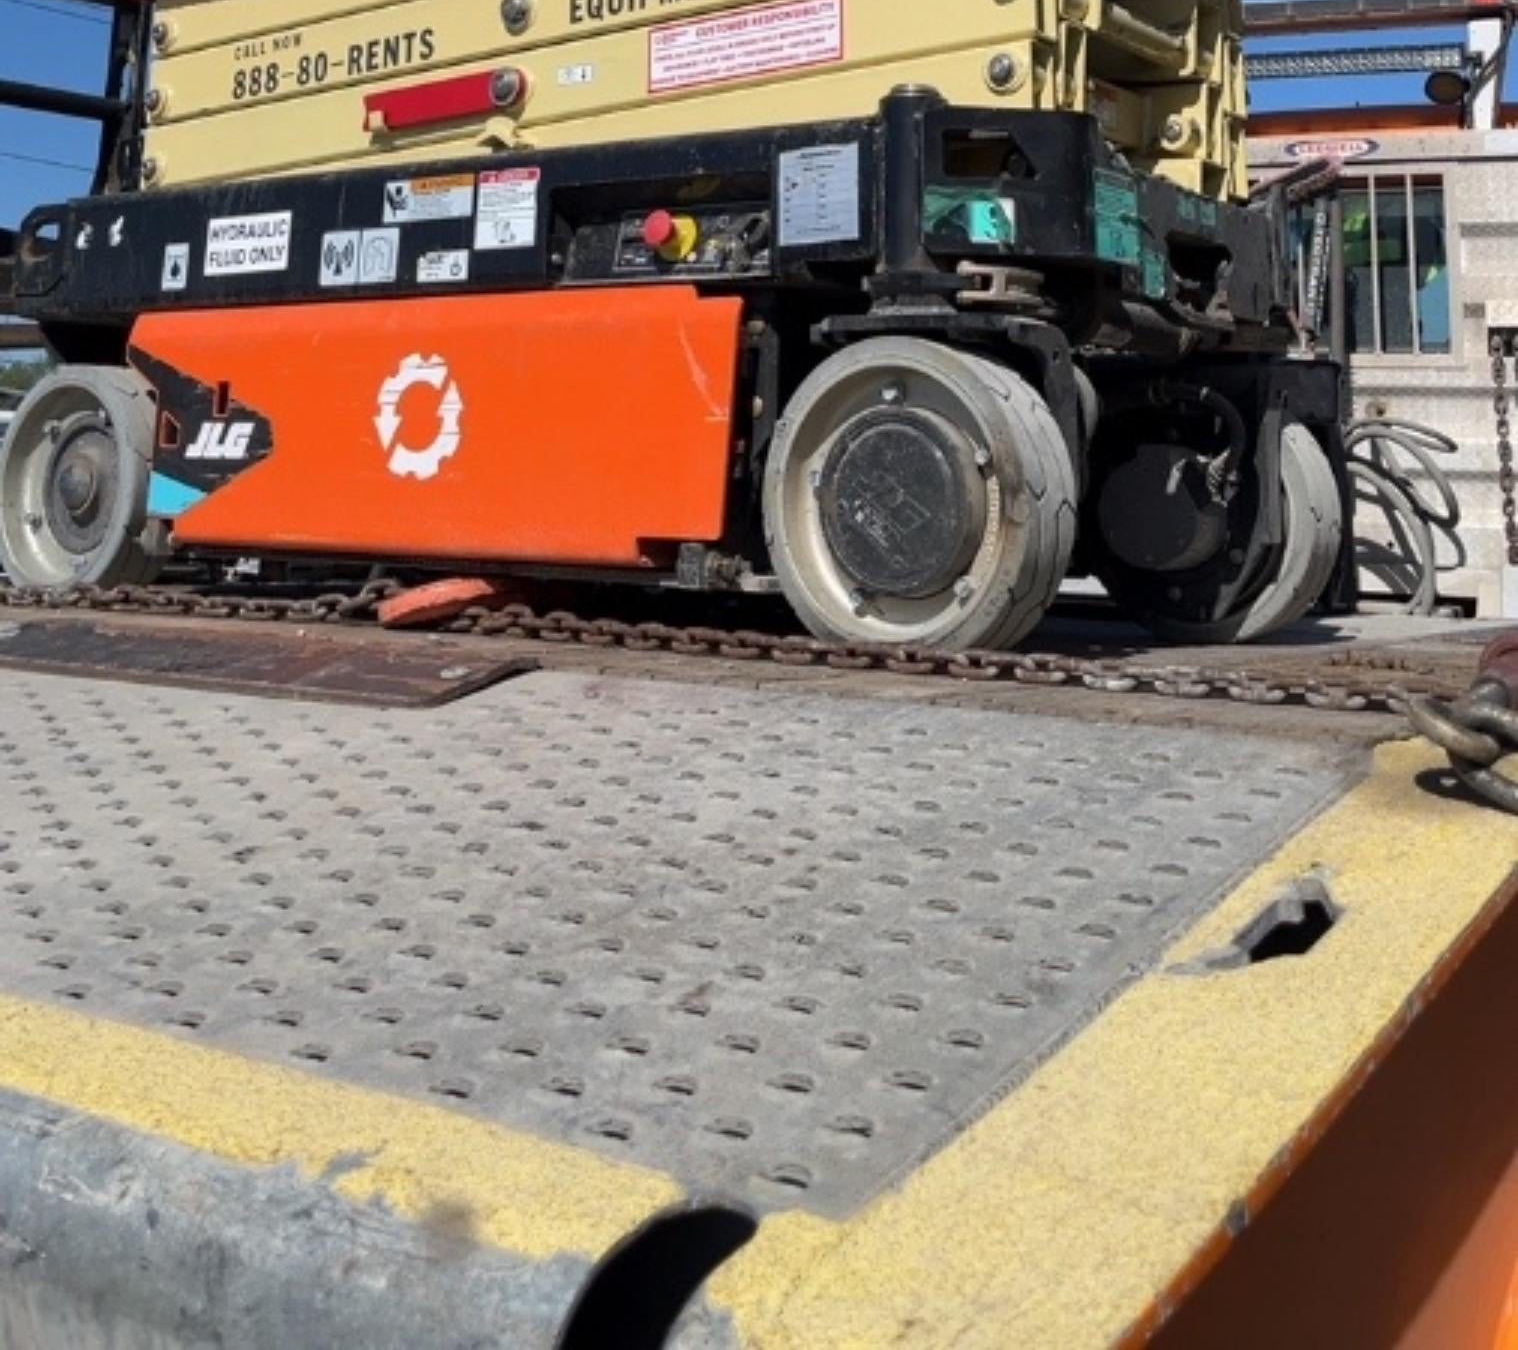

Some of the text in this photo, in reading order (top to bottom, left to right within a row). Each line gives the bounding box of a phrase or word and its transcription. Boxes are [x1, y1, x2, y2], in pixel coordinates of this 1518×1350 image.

[234, 32, 303, 61] CALL NOW
[232, 27, 435, 100] 888-80-RENTS
[208, 217, 287, 243] HYDRAULIC
[209, 244, 287, 268] FLUID ONLY
[183, 421, 256, 459] JLG
